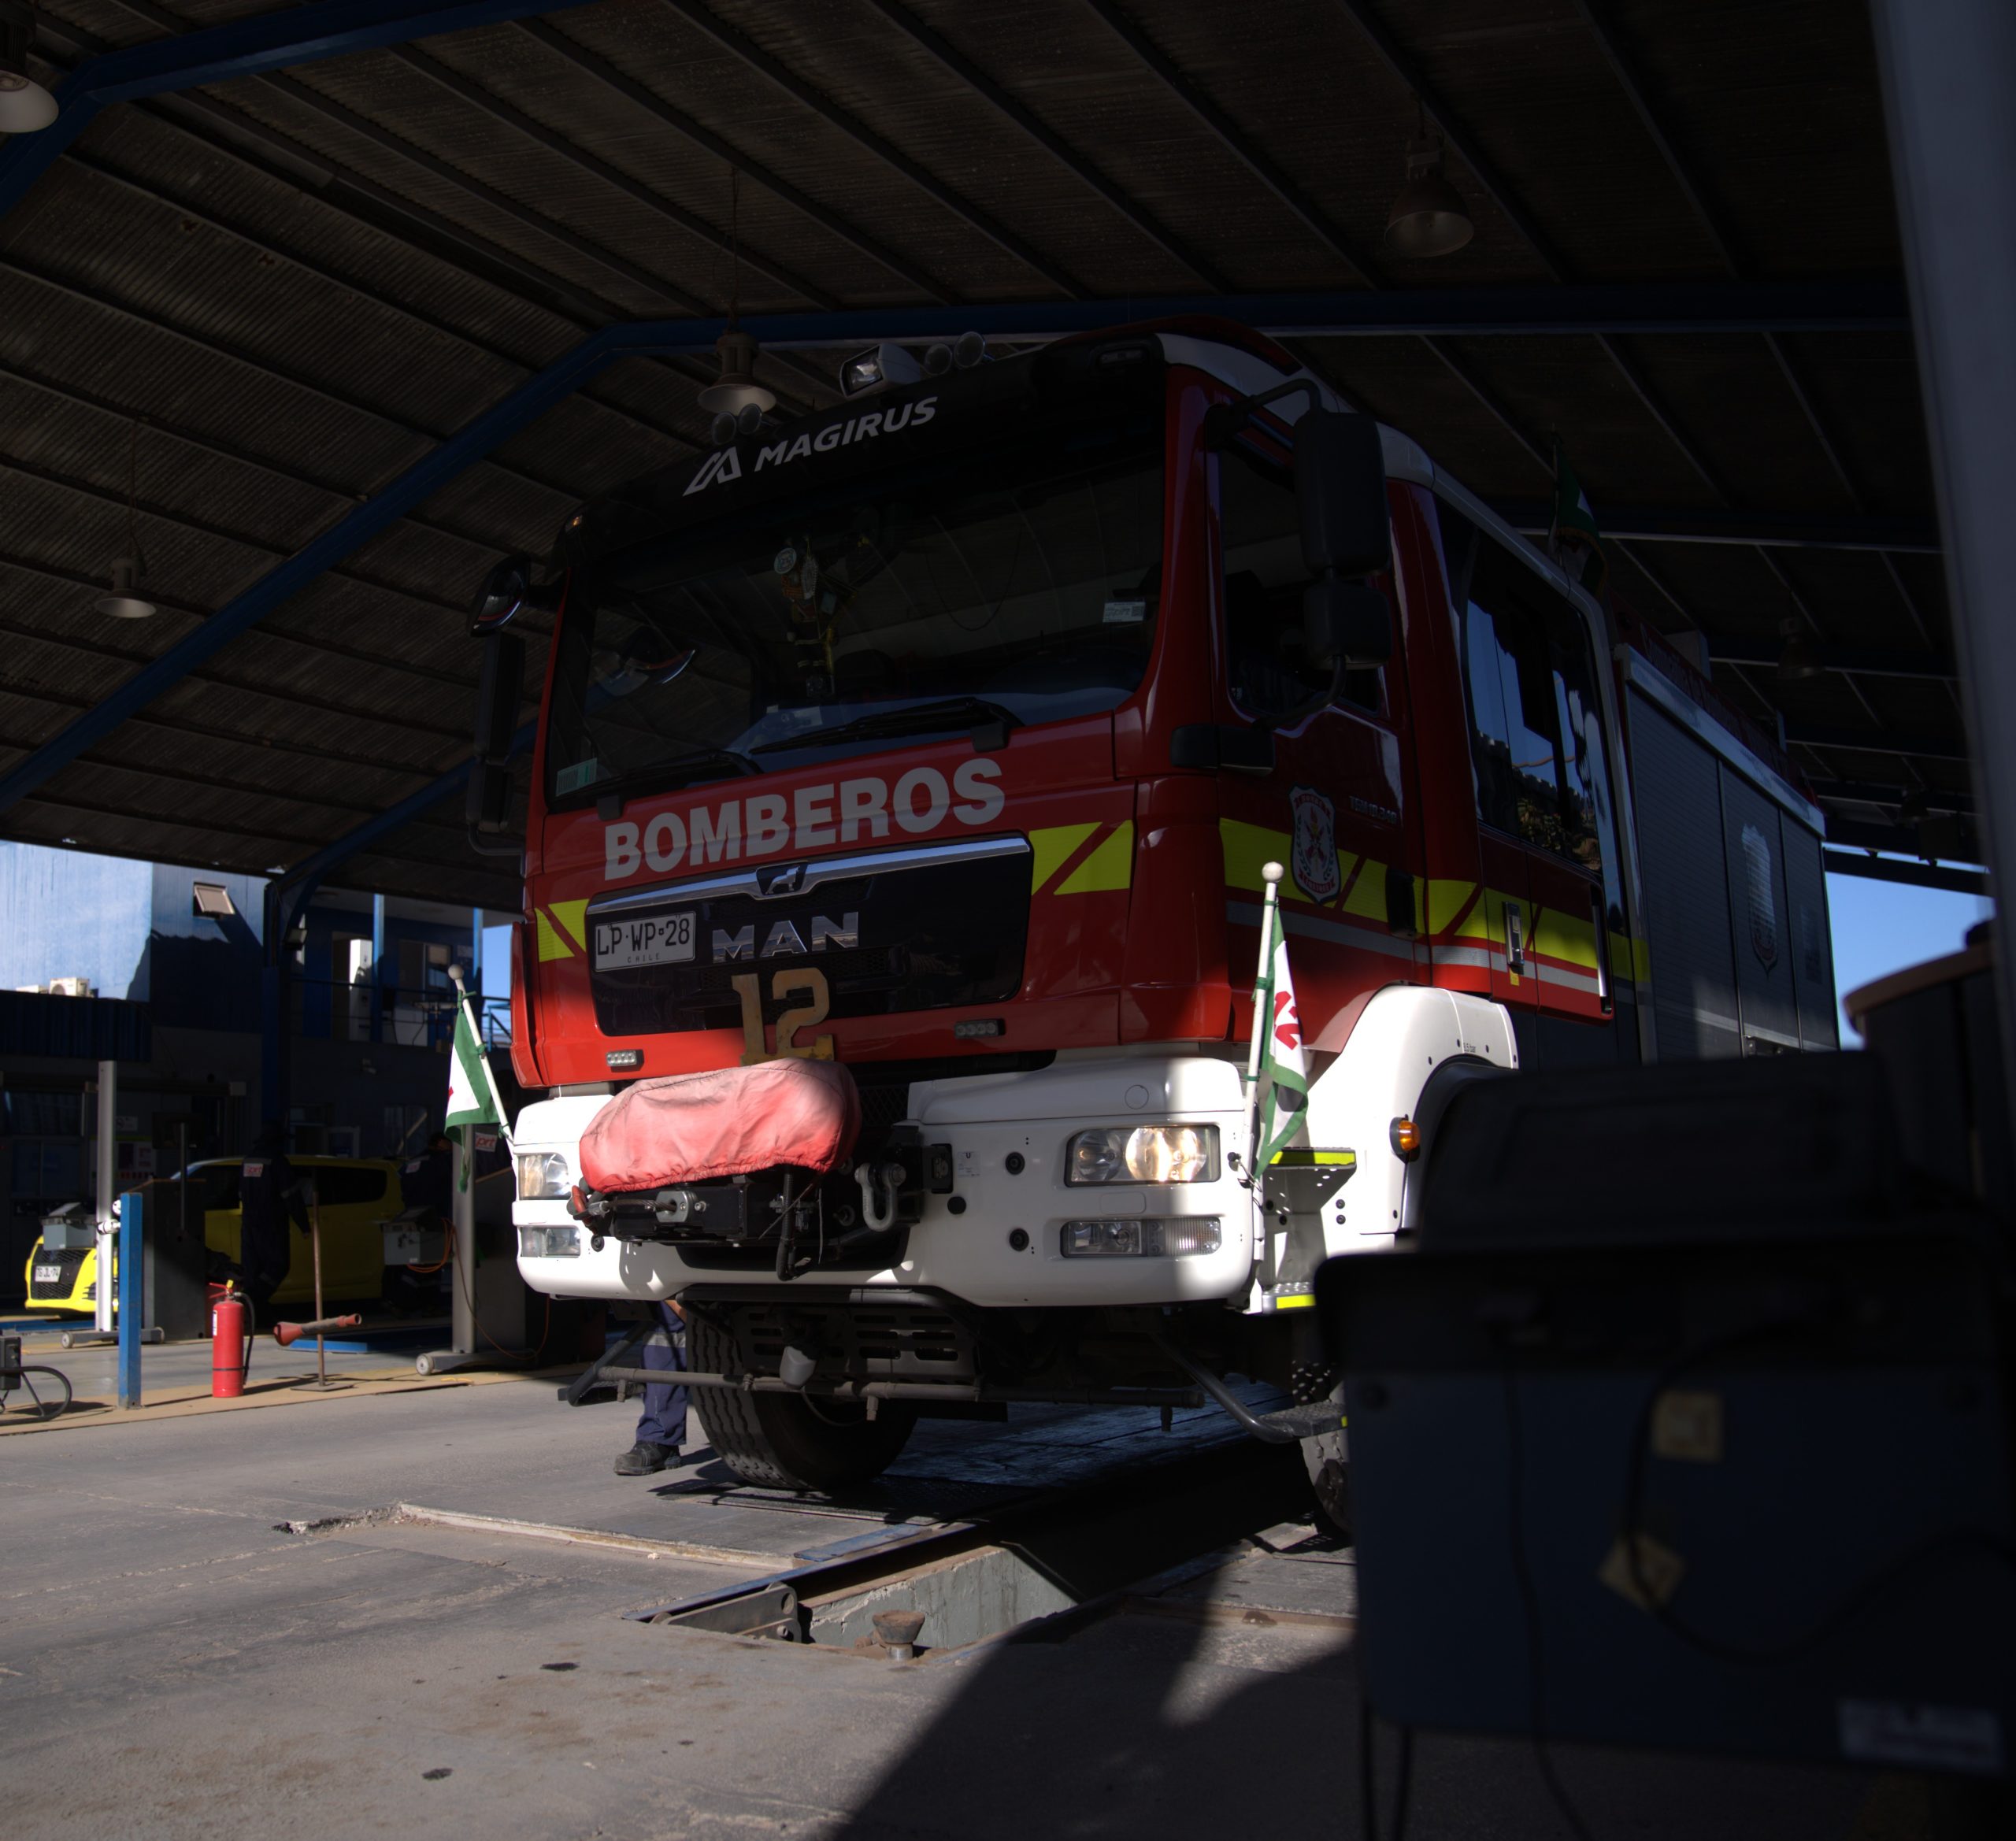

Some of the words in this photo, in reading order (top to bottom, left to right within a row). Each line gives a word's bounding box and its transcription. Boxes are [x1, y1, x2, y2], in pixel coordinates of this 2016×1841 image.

[754, 396, 939, 473] MAGIRUS
[604, 758, 1005, 881] BOMBEROS
[627, 952, 661, 964] CHILE
[711, 911, 860, 965] MAN
[731, 967, 835, 1065] 12
